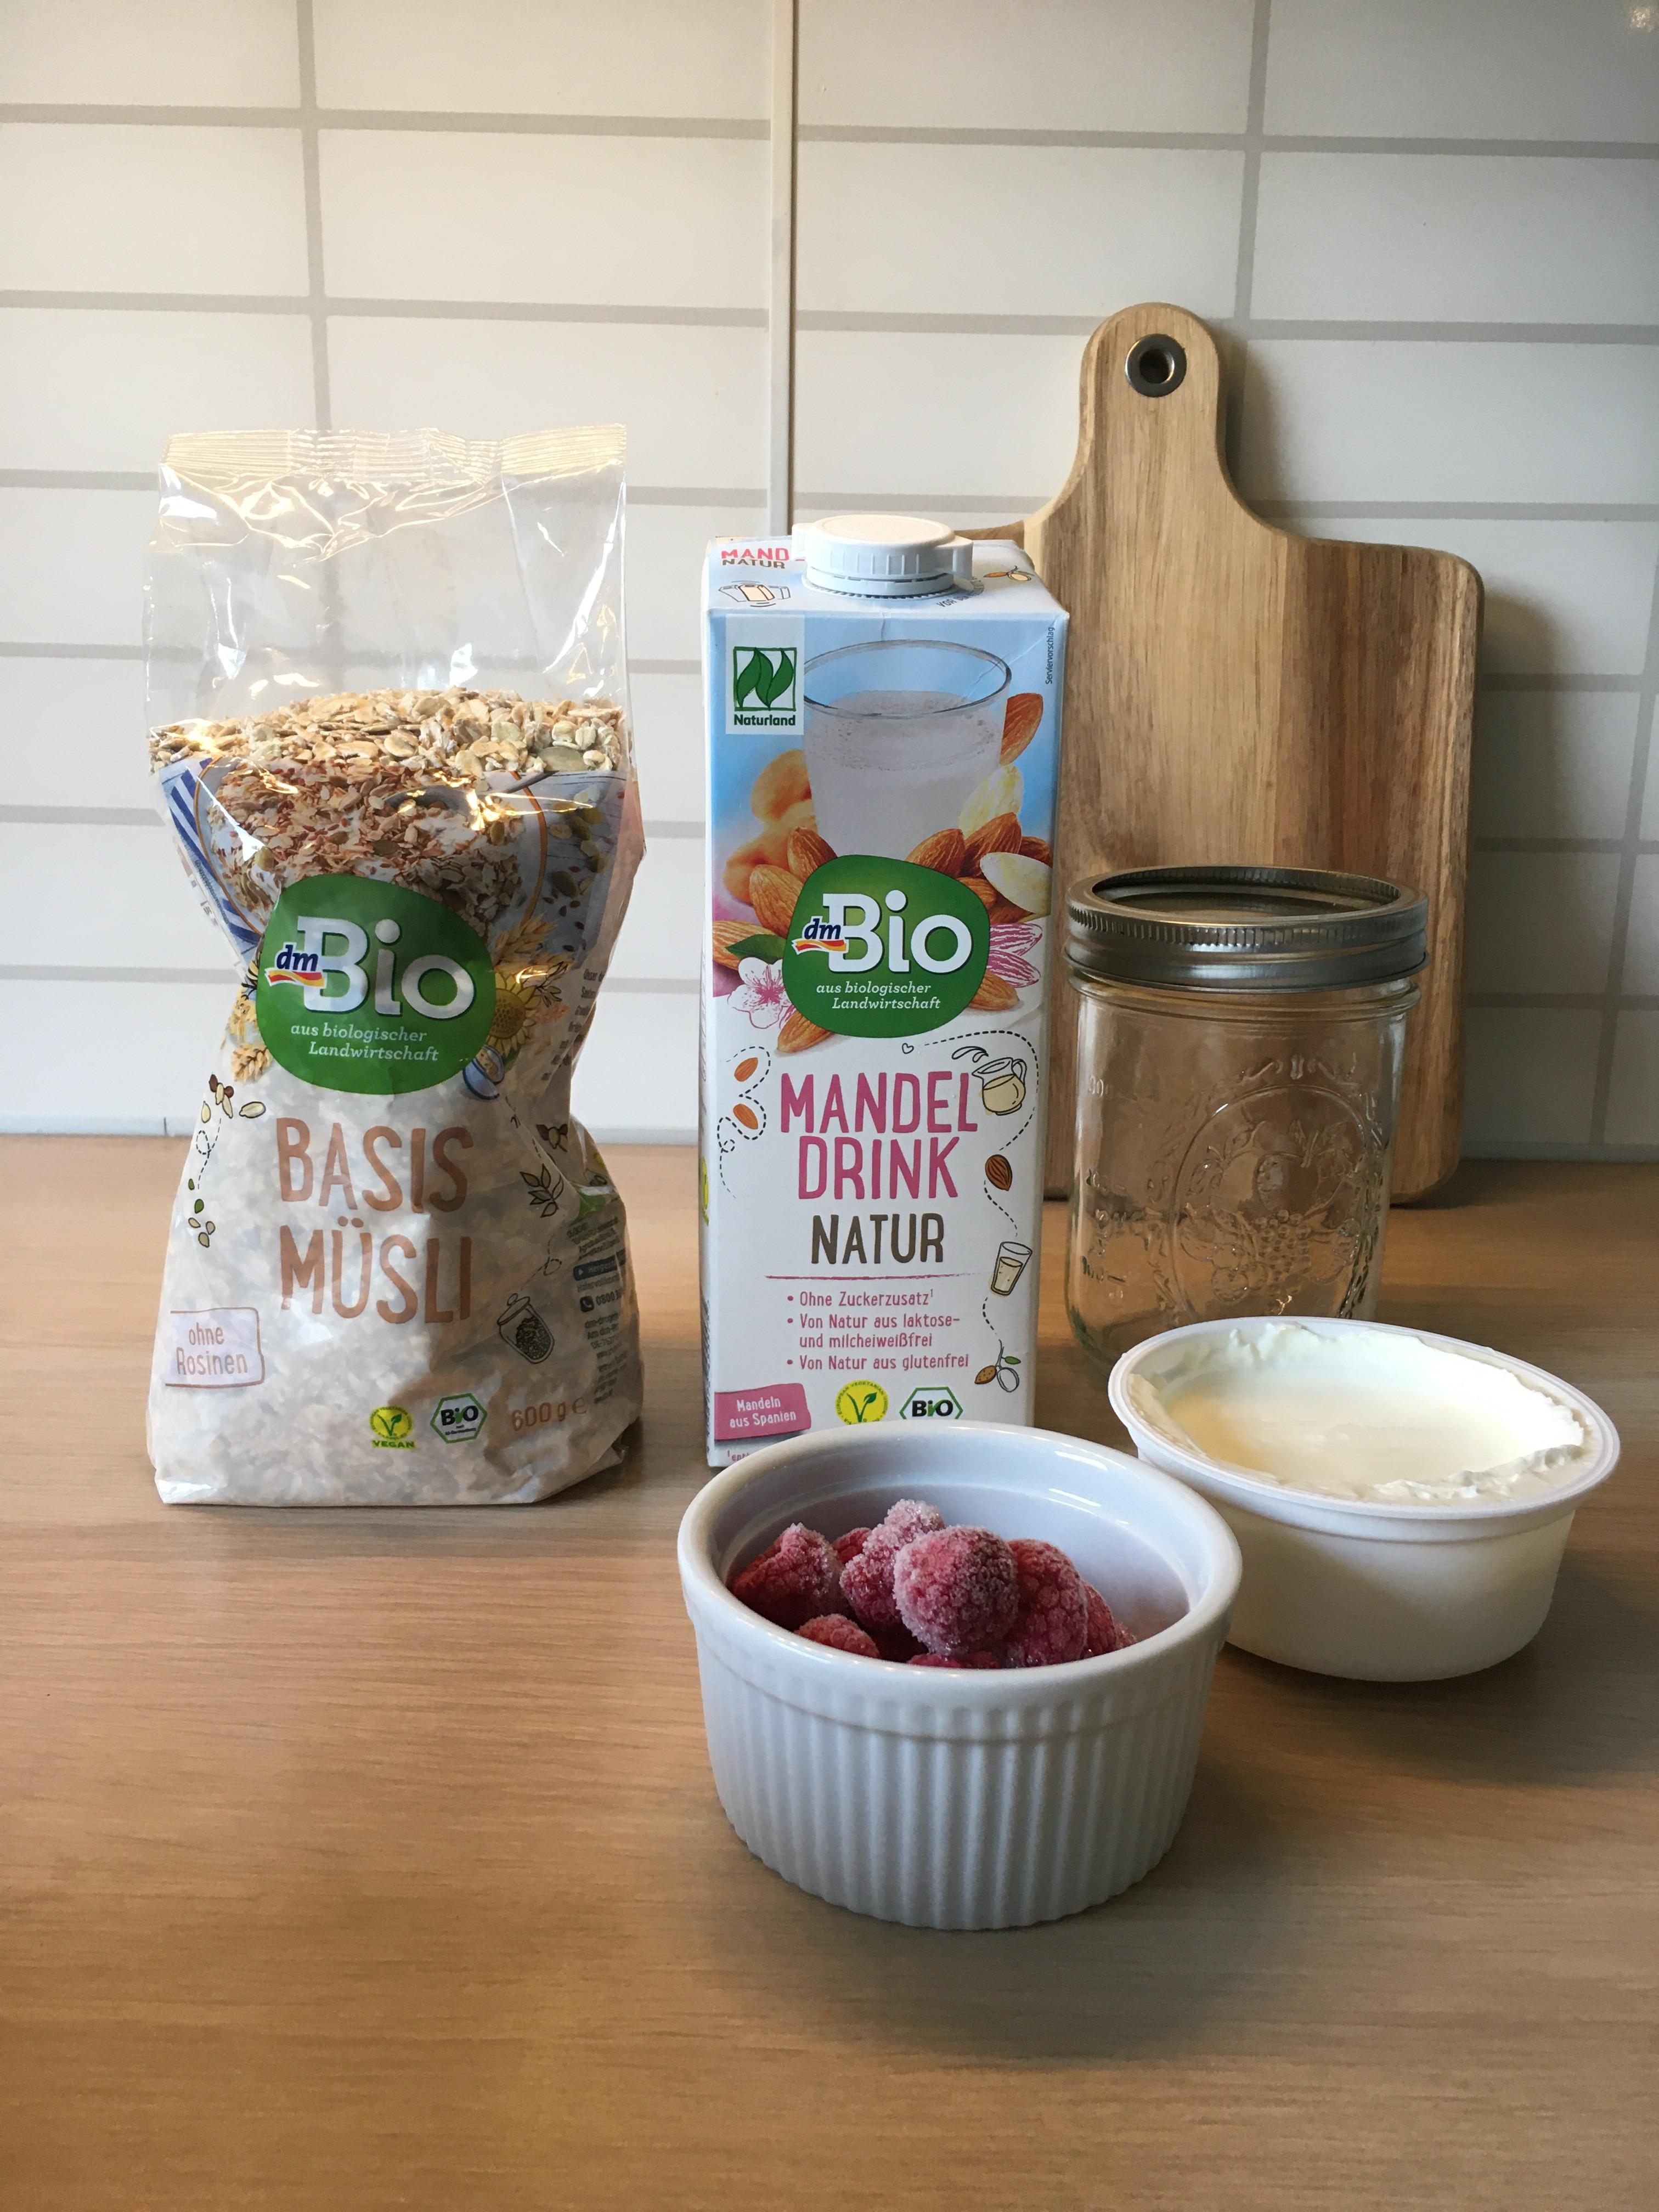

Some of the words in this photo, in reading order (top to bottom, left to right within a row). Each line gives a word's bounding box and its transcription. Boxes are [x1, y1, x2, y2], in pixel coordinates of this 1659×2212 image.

[721, 548, 805, 562] MAND
[722, 558, 786, 569] NATUR
[1045, 627, 1056, 685] Serviervorschlag
[734, 714, 795, 726] Naturland
[804, 918, 841, 940] dm
[823, 889, 972, 974] Bio
[276, 944, 319, 972] dm
[297, 916, 475, 1019] Bio
[816, 984, 842, 994] aus
[845, 981, 931, 996] biologischer
[832, 996, 941, 1009] Landwirtschaft
[291, 1024, 319, 1036] aus
[323, 1023, 427, 1042] biologischer
[308, 1042, 438, 1061] Landwirtschaft
[781, 1071, 978, 1133] MANDEL
[276, 1117, 474, 1214] BASIS
[798, 1136, 960, 1199] DRINK
[811, 1213, 944, 1265] NATUR
[280, 1216, 472, 1324] MÜSLI
[799, 1291, 832, 1306] Ohne
[800, 1313, 823, 1328] Von
[829, 1314, 868, 1328] Natur
[874, 1316, 898, 1328] aus
[903, 1313, 960, 1327] laktose-
[189, 1322, 224, 1345] ohne
[799, 1333, 823, 1347] und
[829, 1333, 932, 1347] milcheiweißfrei
[176, 1347, 247, 1375] Rosinen
[799, 1355, 822, 1369] Von
[828, 1355, 867, 1369] Natur
[873, 1358, 896, 1369] aus
[902, 1353, 969, 1371] glutenfrei
[737, 1396, 781, 1412] Mandeln
[512, 1402, 551, 1431] 600
[557, 1402, 566, 1422] g
[730, 1417, 749, 1428] aus
[752, 1410, 796, 1426] Spanien
[373, 1440, 415, 1448] VEGAN
